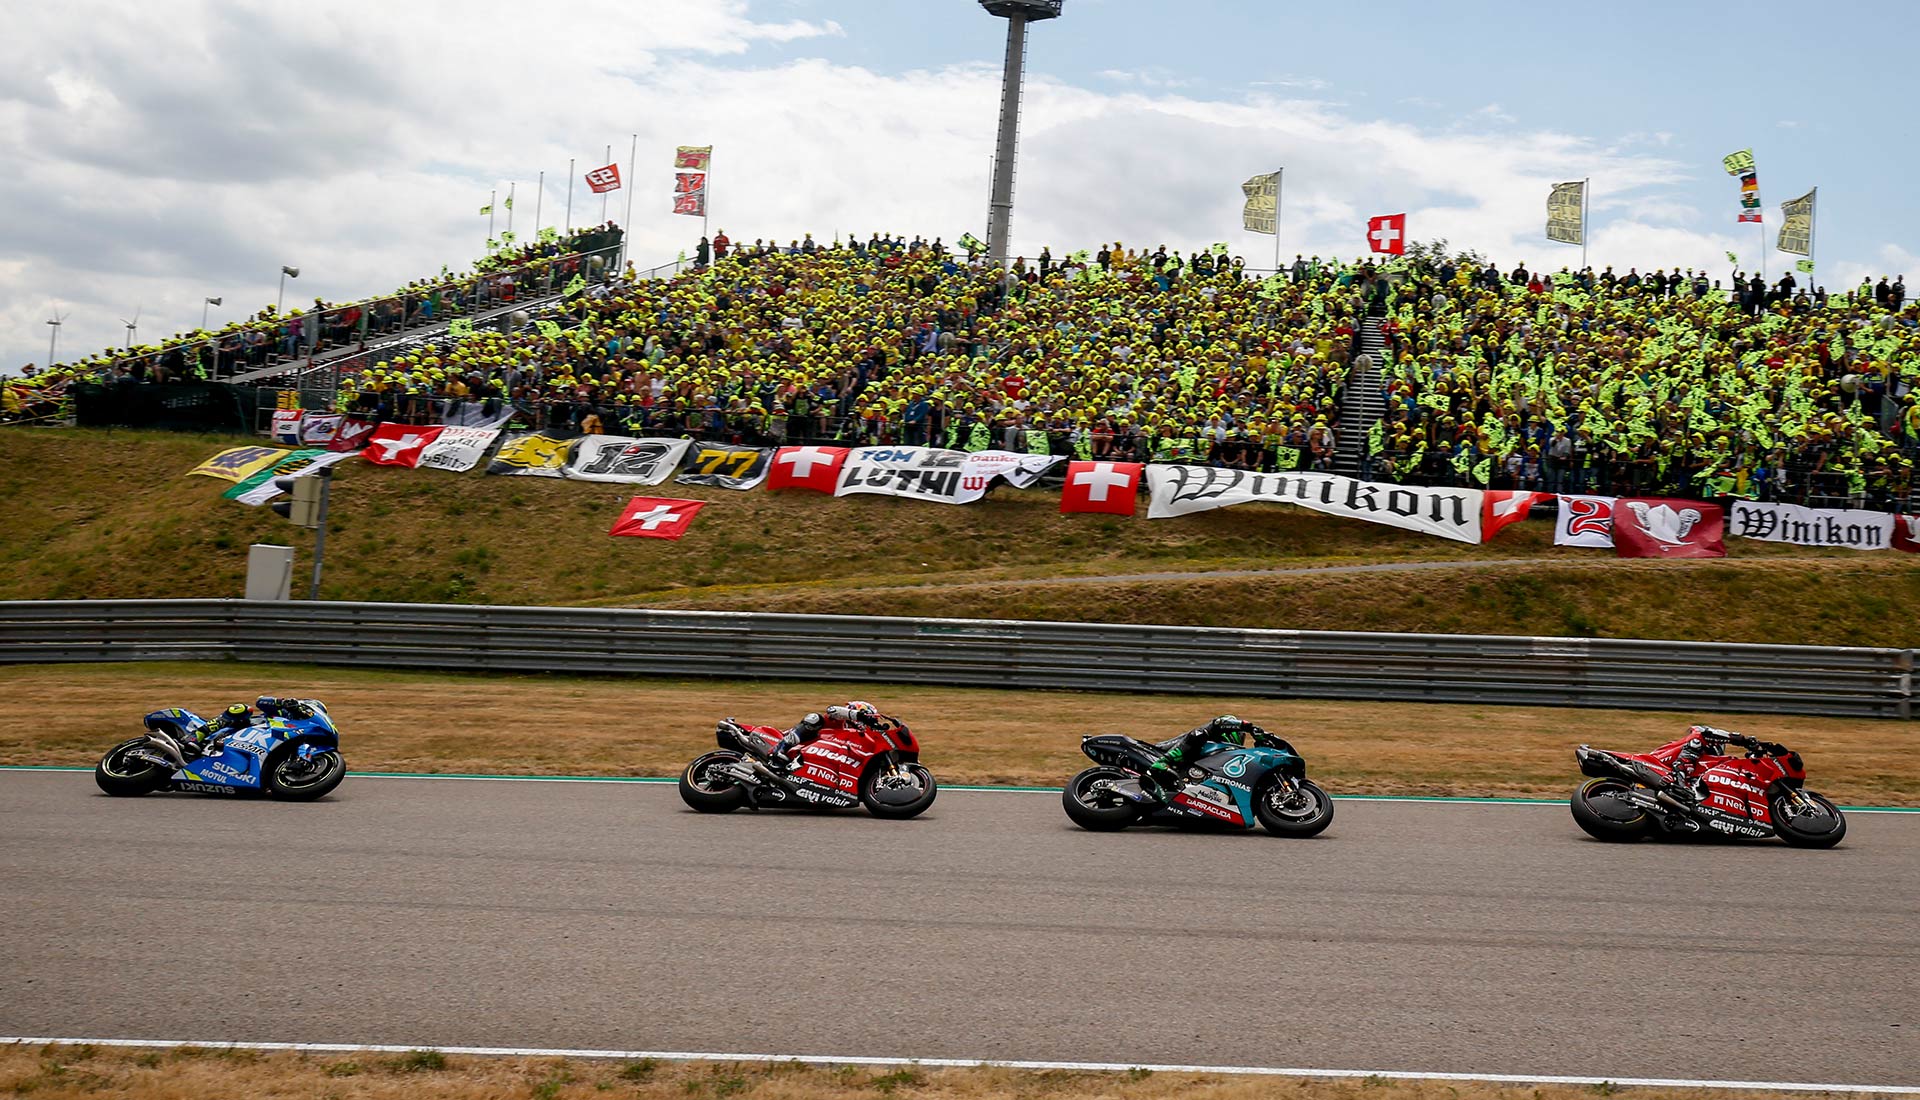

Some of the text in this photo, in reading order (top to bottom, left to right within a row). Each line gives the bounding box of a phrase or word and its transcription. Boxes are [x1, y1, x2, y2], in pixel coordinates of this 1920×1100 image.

[580, 442, 671, 478] 12
[695, 449, 760, 479] 77
[860, 449, 916, 463] TOM
[1167, 464, 1470, 527] Winikon
[1736, 505, 1884, 548] Winikon
[806, 746, 861, 768] DUCATI
[200, 768, 228, 784] MOTUL
[212, 761, 257, 785] SUZUKI
[1211, 775, 1252, 793] PETRONAS
[796, 788, 820, 802] GIVI
[1708, 774, 1765, 797] DUCATI
[821, 794, 851, 807] valsir
[1186, 798, 1232, 820] BARRACUDA
[1709, 819, 1735, 833] GIVI
[1735, 825, 1766, 838] valsir
